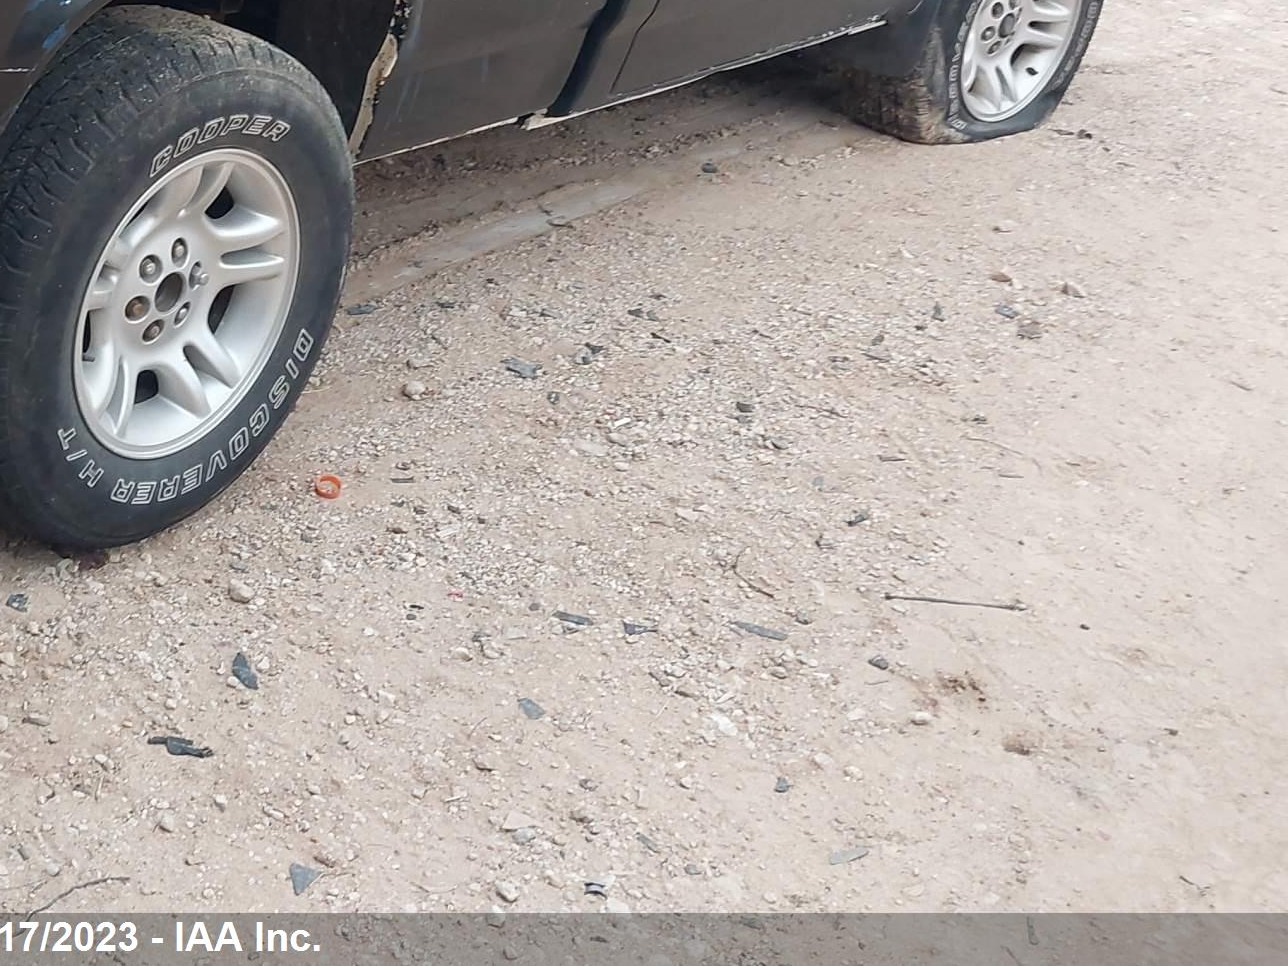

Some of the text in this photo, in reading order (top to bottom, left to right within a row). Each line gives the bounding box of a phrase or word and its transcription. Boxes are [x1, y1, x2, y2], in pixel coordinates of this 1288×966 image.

[149, 114, 291, 178] COOPER
[57, 328, 314, 505] DISCOVERER H/T
